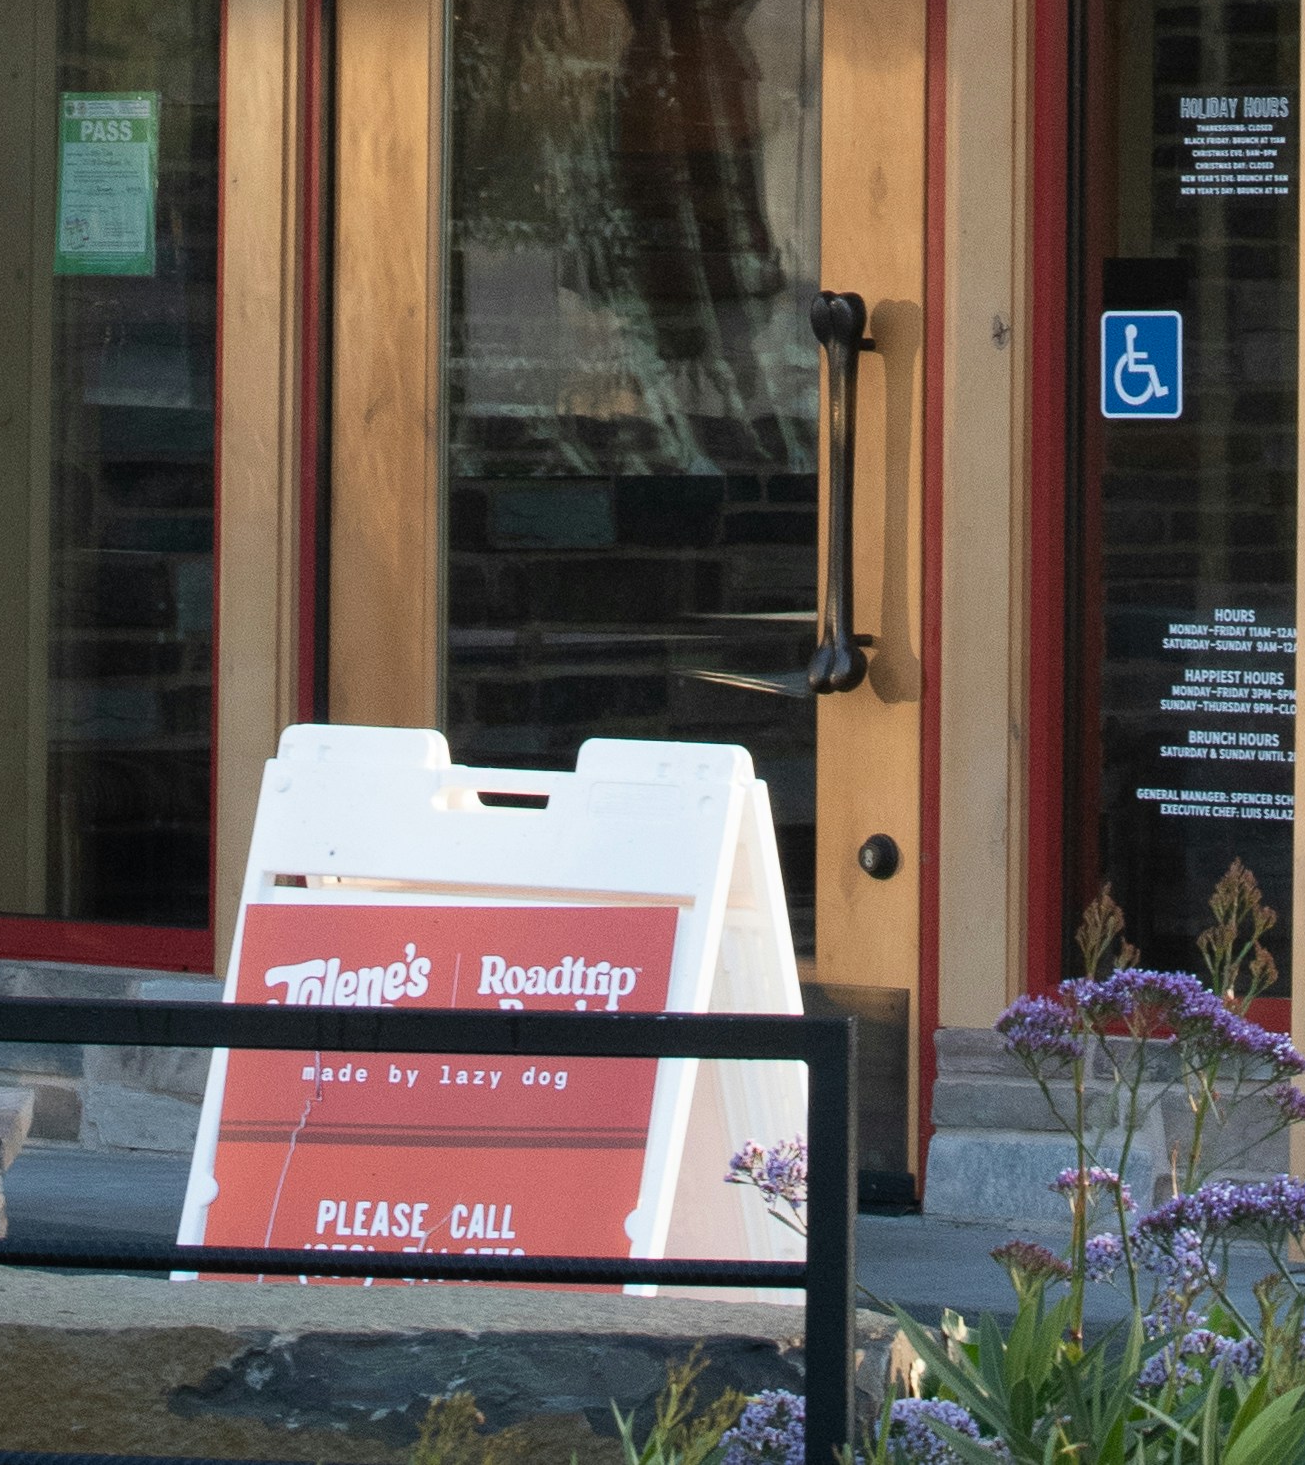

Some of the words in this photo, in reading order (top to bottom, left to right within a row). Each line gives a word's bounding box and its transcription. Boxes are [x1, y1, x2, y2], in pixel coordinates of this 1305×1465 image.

[1181, 97, 1238, 119] HOLIDAY
[1244, 97, 1289, 118] HOURS
[79, 119, 133, 143] PASS
[1181, 187, 1195, 195] NEW
[1197, 187, 1219, 195] YEAR'S
[1237, 187, 1263, 195] BRUNCH
[1214, 609, 1255, 622] HOURS
[1185, 669, 1241, 683] HAPPIEST
[1243, 671, 1284, 685] HOURS
[1188, 730, 1236, 745] BRUNCH
[1239, 733, 1279, 747] HOURS
[1160, 746, 1208, 759] SATURDAY
[1210, 748, 1217, 759] &
[1219, 748, 1255, 760] SUNDAY
[1258, 751, 1285, 762] UNTIL
[1136, 788, 1179, 800] GENERAL
[1181, 790, 1229, 803] MANAGER:
[1231, 792, 1273, 805] SPENCER
[1160, 804, 1210, 817] EXECUTIVE
[1212, 806, 1239, 818] CHEF:
[1241, 808, 1261, 819] LUIS
[1263, 809, 1294, 820] SALAZ
[302, 1063, 368, 1082] made
[388, 1064, 419, 1087] by
[439, 1065, 502, 1089] lazy
[521, 1066, 568, 1089] dog
[316, 1199, 429, 1238] PLEASE
[449, 1204, 515, 1239] CALL
